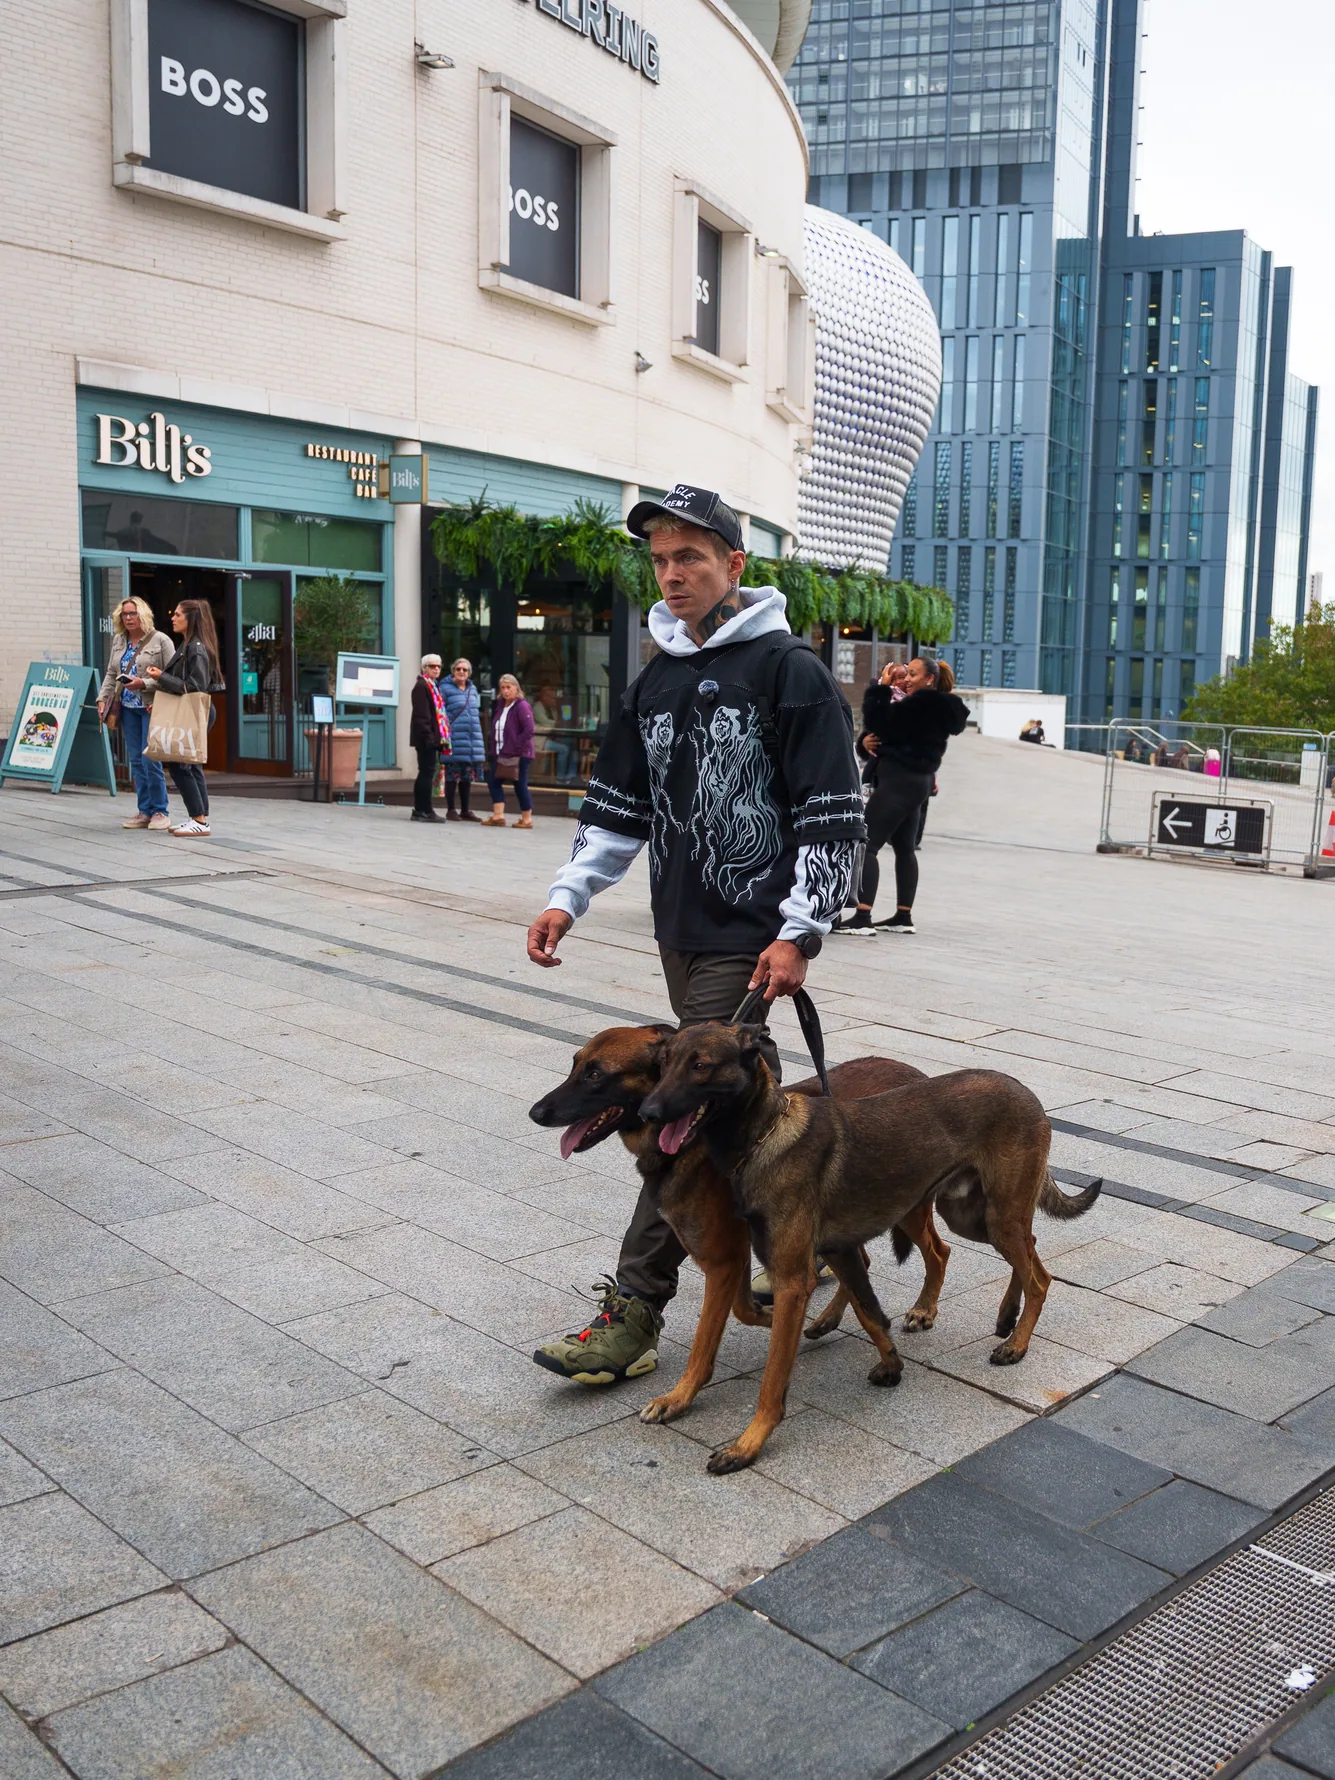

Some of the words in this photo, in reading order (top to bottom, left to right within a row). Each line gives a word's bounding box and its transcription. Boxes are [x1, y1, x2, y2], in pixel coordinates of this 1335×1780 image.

[537, 0, 660, 84] LRING
[161, 55, 269, 124] BOSS
[96, 412, 212, 483] Bill's
[306, 443, 377, 466] RESTAURANT
[350, 466, 377, 482] CAFÉ
[392, 469, 420, 489] Bill's
[356, 483, 377, 498] BAR
